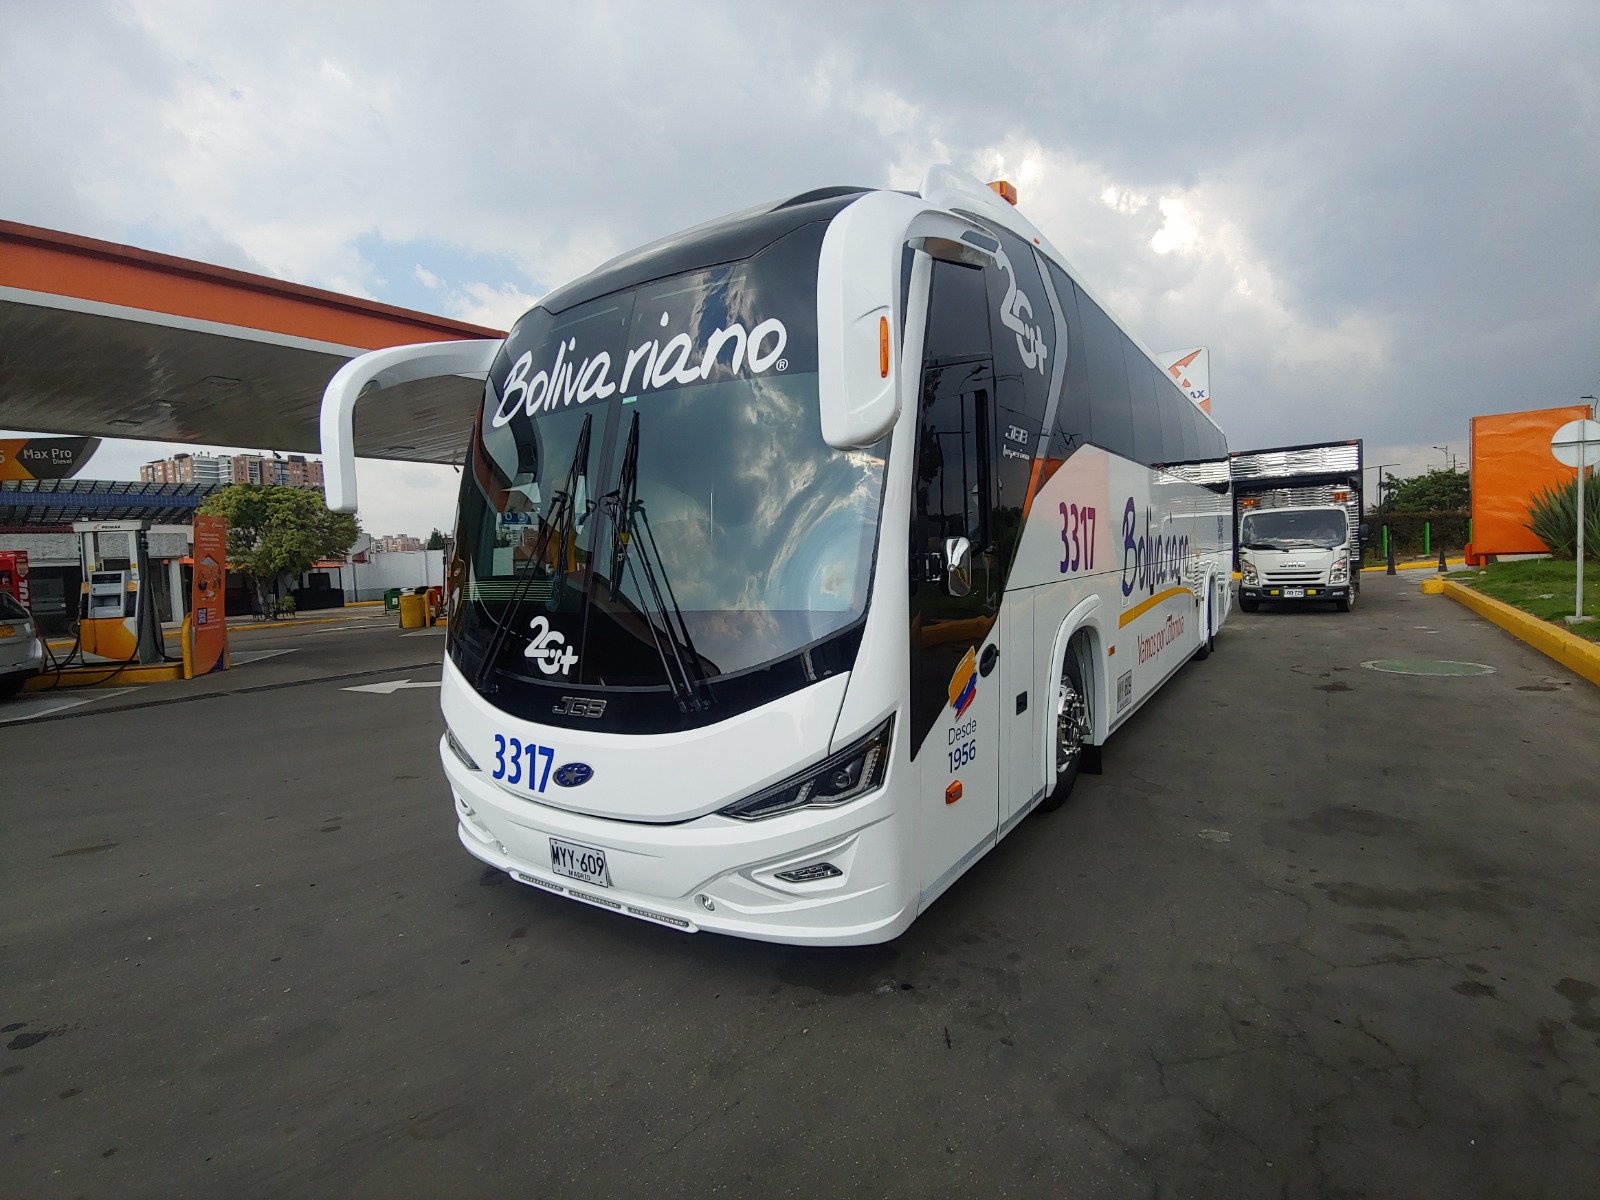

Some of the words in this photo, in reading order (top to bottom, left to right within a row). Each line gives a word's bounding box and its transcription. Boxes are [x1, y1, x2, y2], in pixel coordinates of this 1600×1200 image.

[491, 312, 788, 428] Bolivariano
[23, 449, 48, 459] Max
[51, 448, 72, 459] Pro
[1059, 501, 1096, 574] 3317
[1137, 634, 1157, 666] Vamos
[551, 695, 608, 719] JGB
[948, 717, 977, 746] Desde
[492, 733, 555, 793] 3317
[948, 739, 977, 774] 1956
